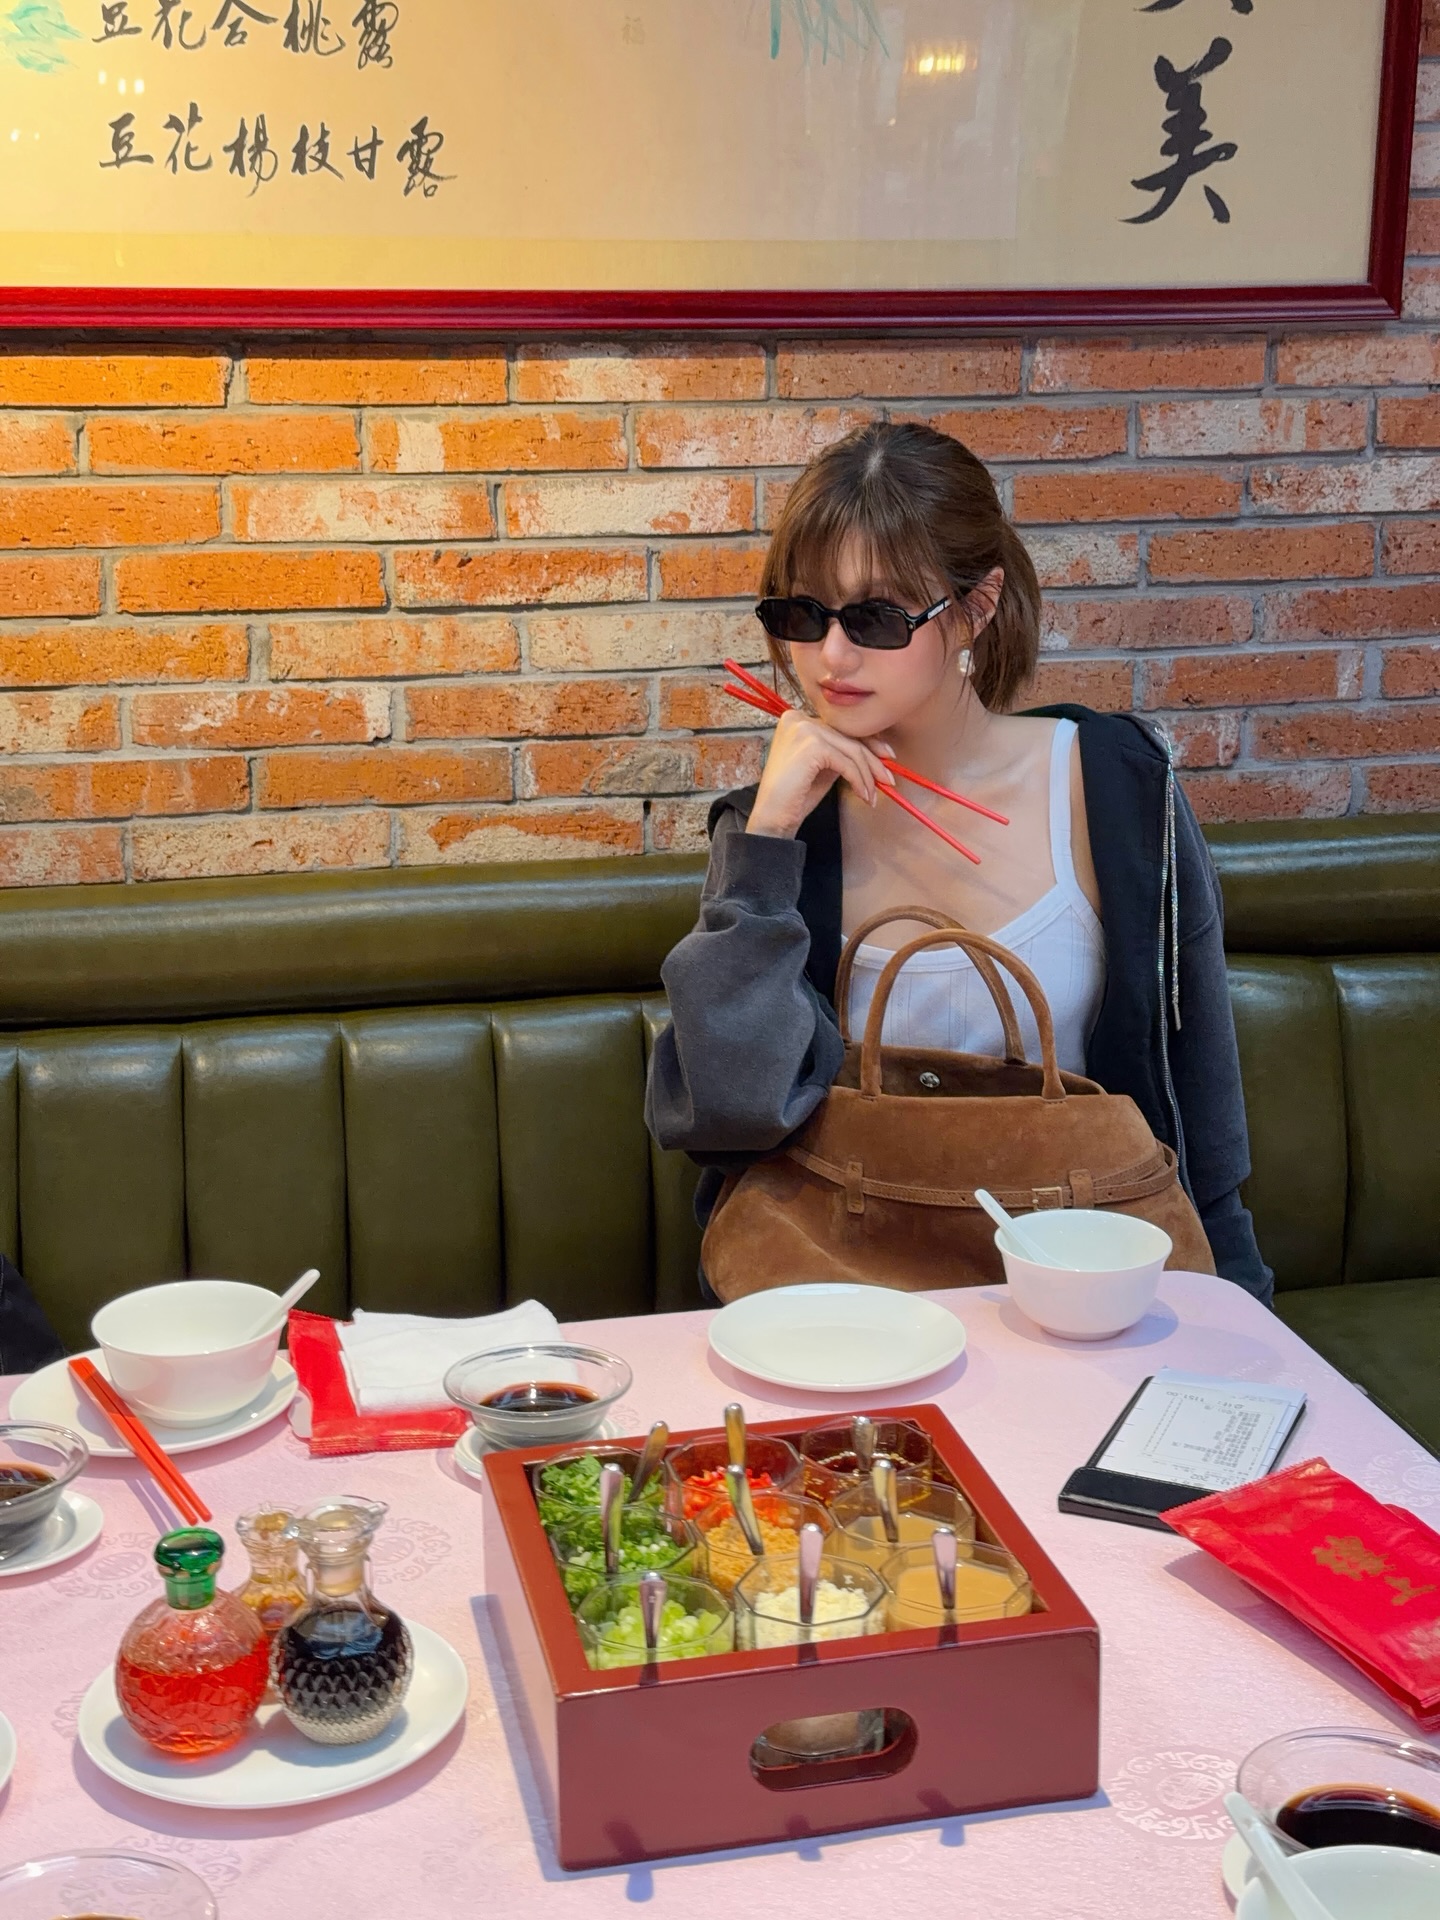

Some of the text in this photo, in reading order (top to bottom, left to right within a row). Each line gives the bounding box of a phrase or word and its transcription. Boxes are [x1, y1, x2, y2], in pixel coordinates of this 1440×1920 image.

[99, 101, 458, 198] 豆花楊枝甘露
[1119, 0, 1255, 225] 美
